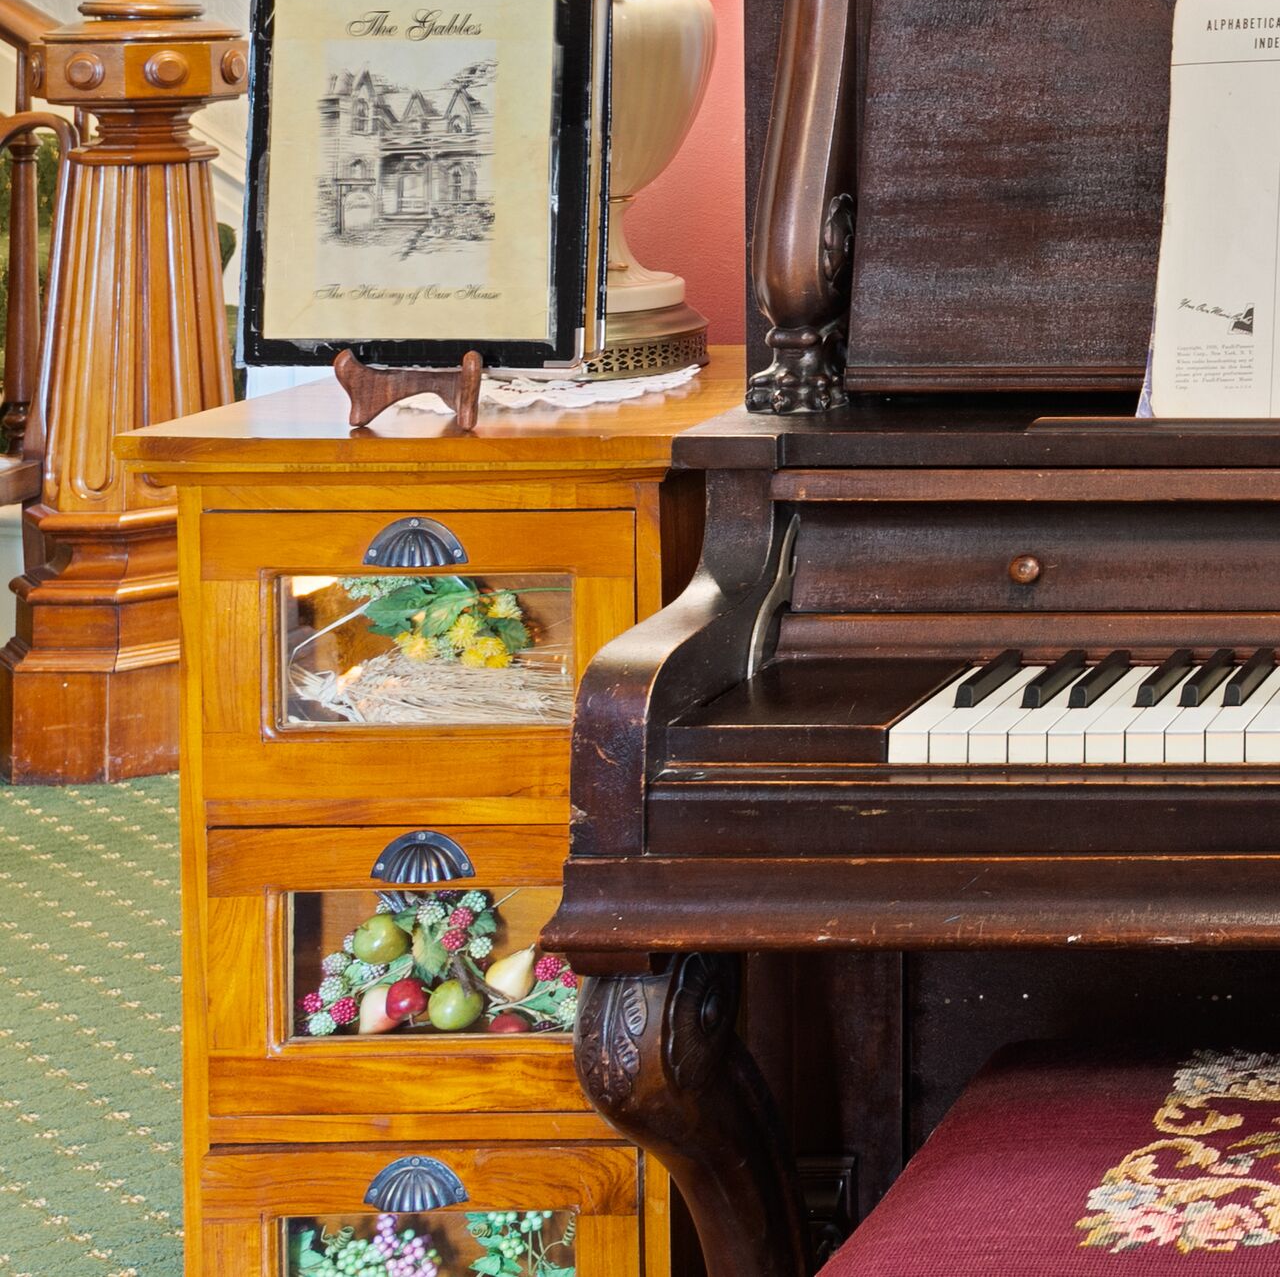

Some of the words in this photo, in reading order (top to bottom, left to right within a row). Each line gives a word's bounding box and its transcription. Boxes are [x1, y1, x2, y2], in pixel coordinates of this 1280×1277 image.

[346, 9, 398, 38] The
[405, 9, 482, 41] Gables
[349, 283, 404, 305] History
[406, 285, 421, 306] of
[455, 284, 501, 301] House
